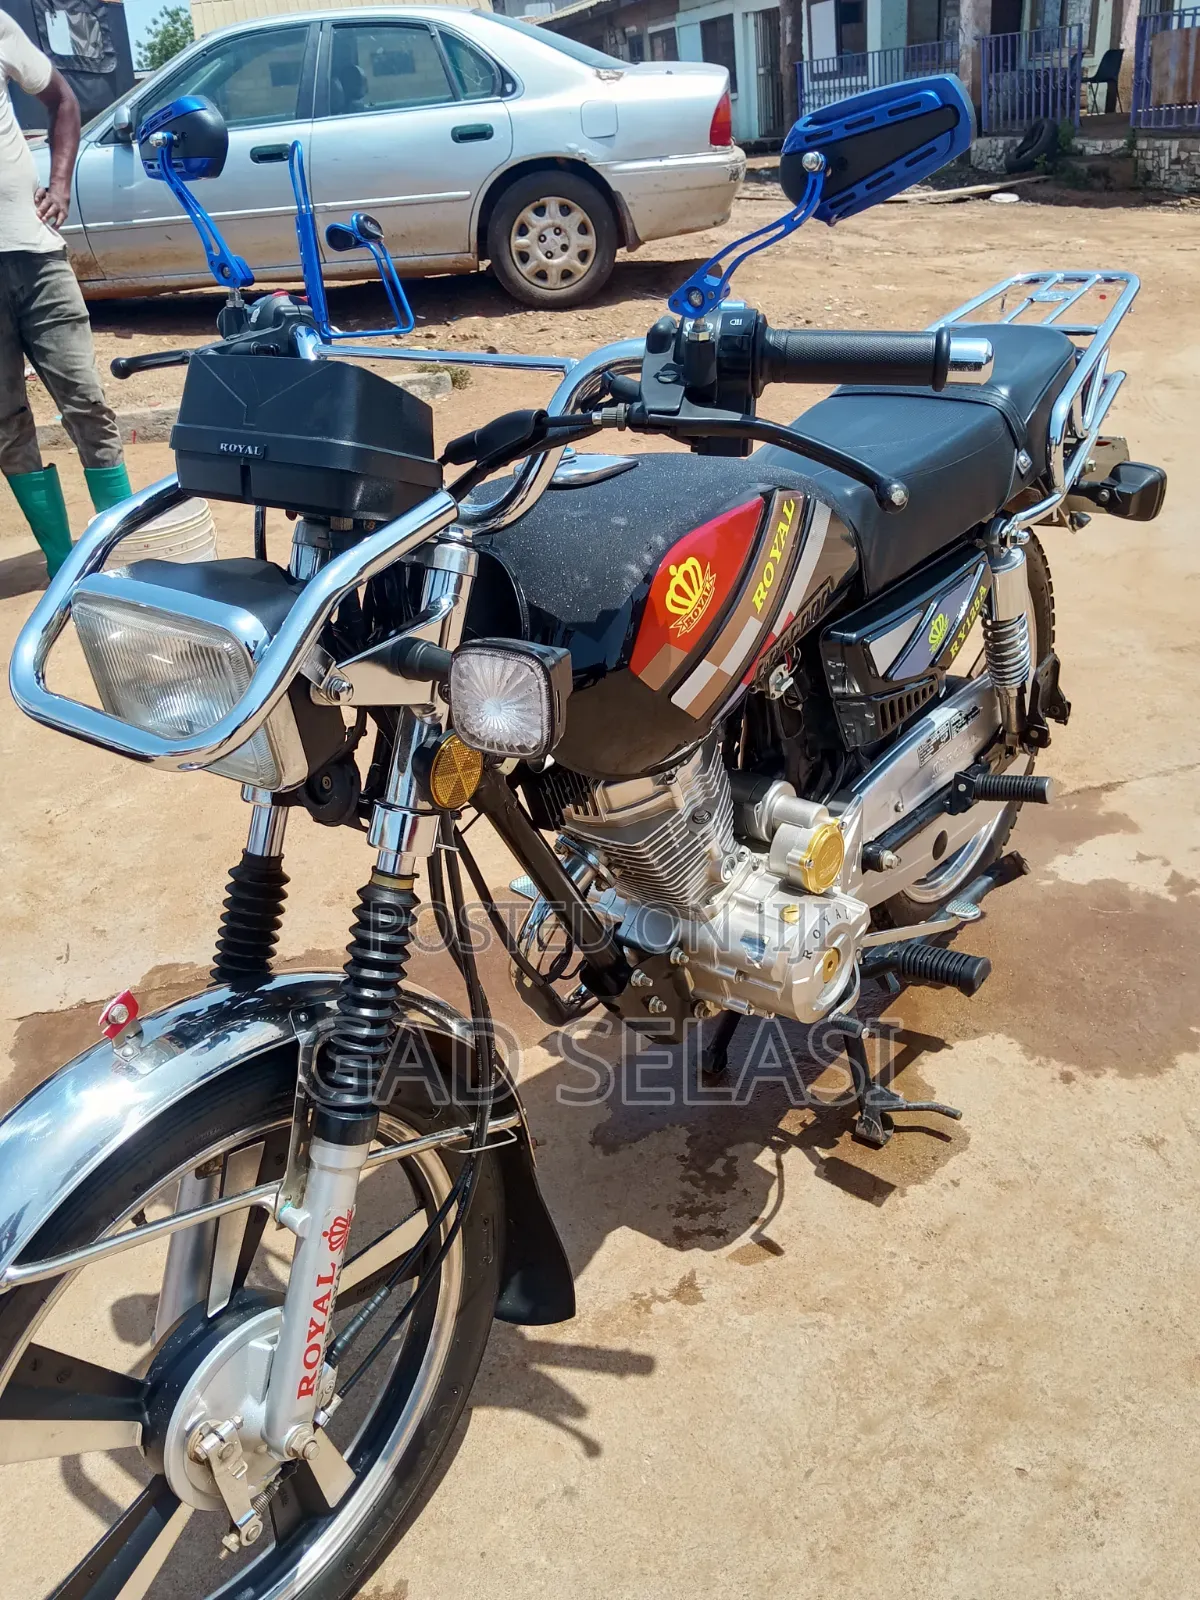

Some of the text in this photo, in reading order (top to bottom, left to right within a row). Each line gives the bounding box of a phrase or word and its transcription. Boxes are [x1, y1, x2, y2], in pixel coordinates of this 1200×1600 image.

[219, 442, 263, 456] ROYAL
[751, 497, 796, 615] ROYAL
[685, 582, 712, 628] ROYAL
[949, 585, 987, 659] RY125A
[801, 908, 850, 961] ROYAL
[296, 1261, 337, 1400] ROYAL
